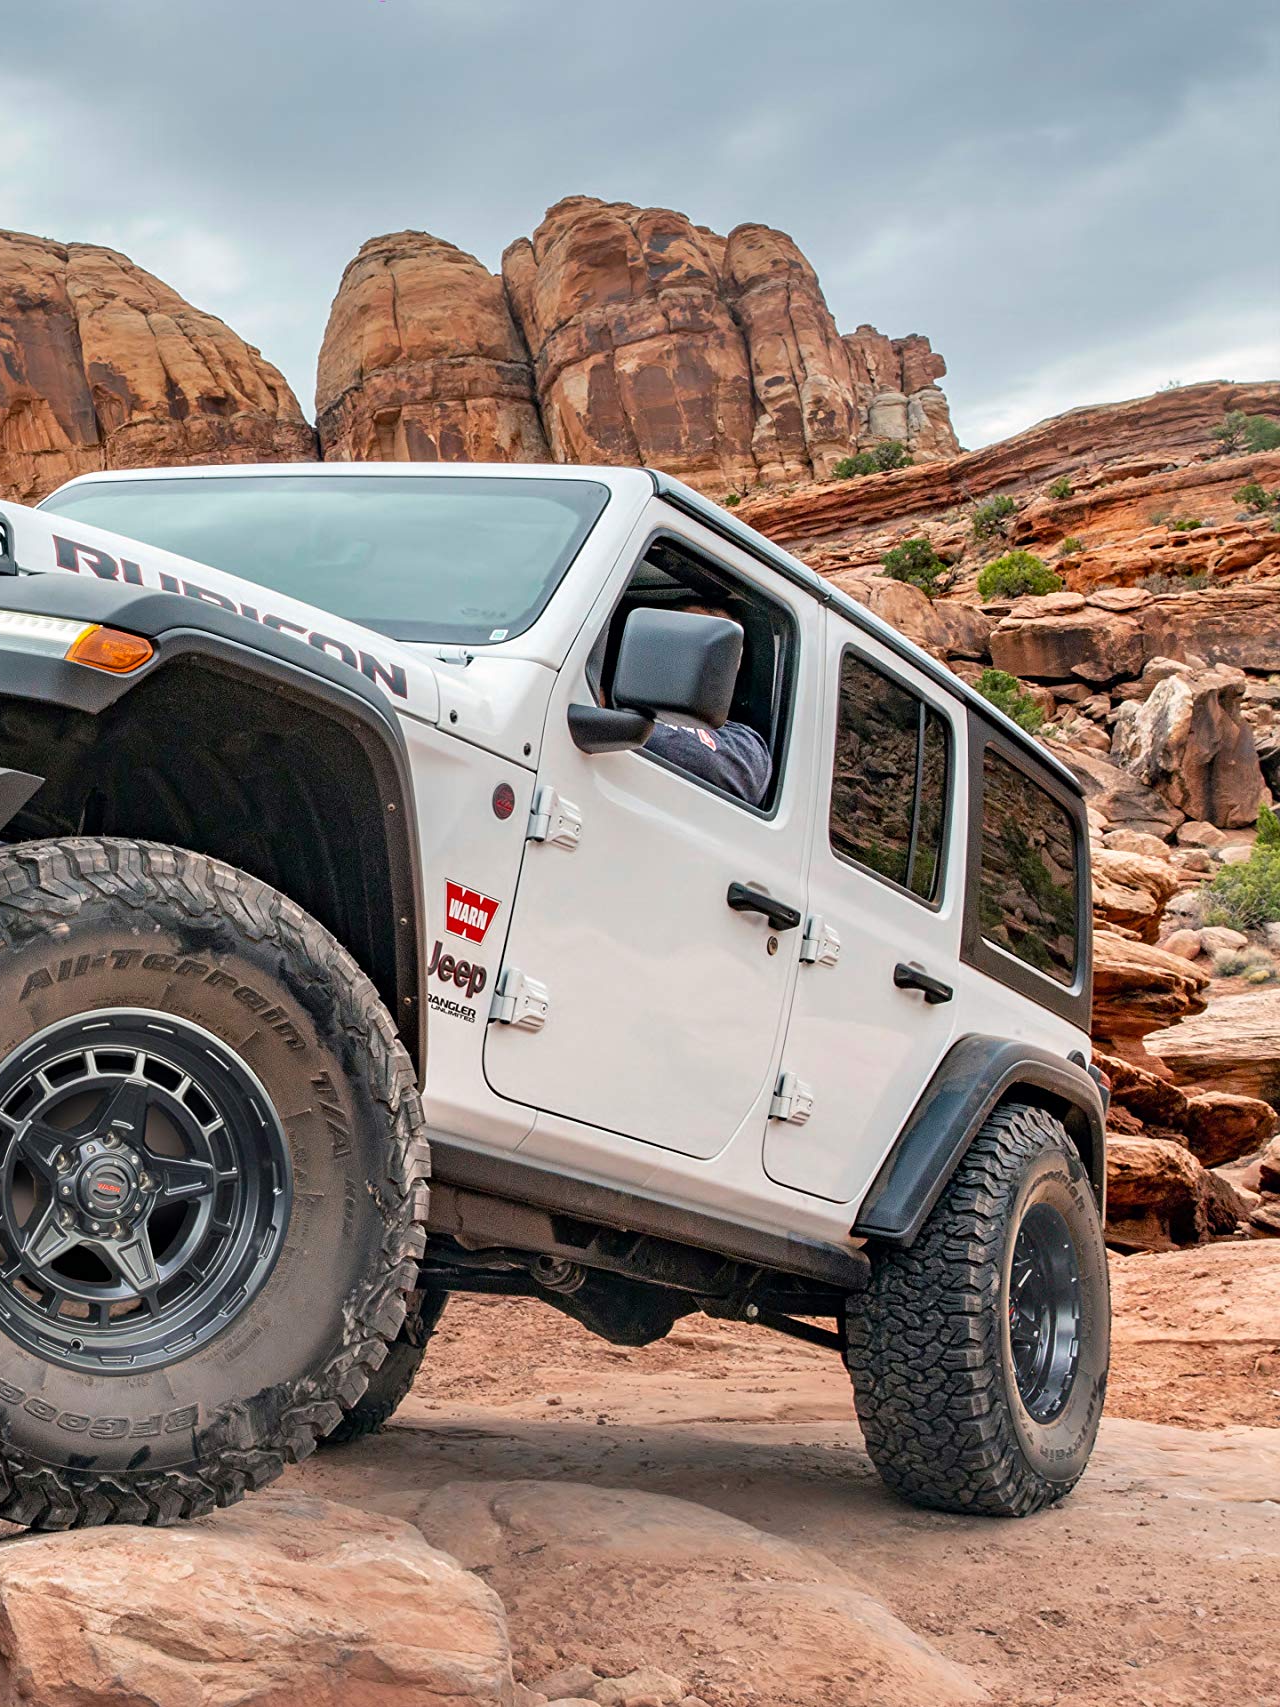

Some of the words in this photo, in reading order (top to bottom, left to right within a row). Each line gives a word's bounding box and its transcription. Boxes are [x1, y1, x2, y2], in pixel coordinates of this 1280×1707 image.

[449, 898, 488, 930] WARN
[428, 940, 487, 998] Jeep
[427, 993, 477, 1018] RANGLER
[430, 1003, 475, 1023] UNLIMITED
